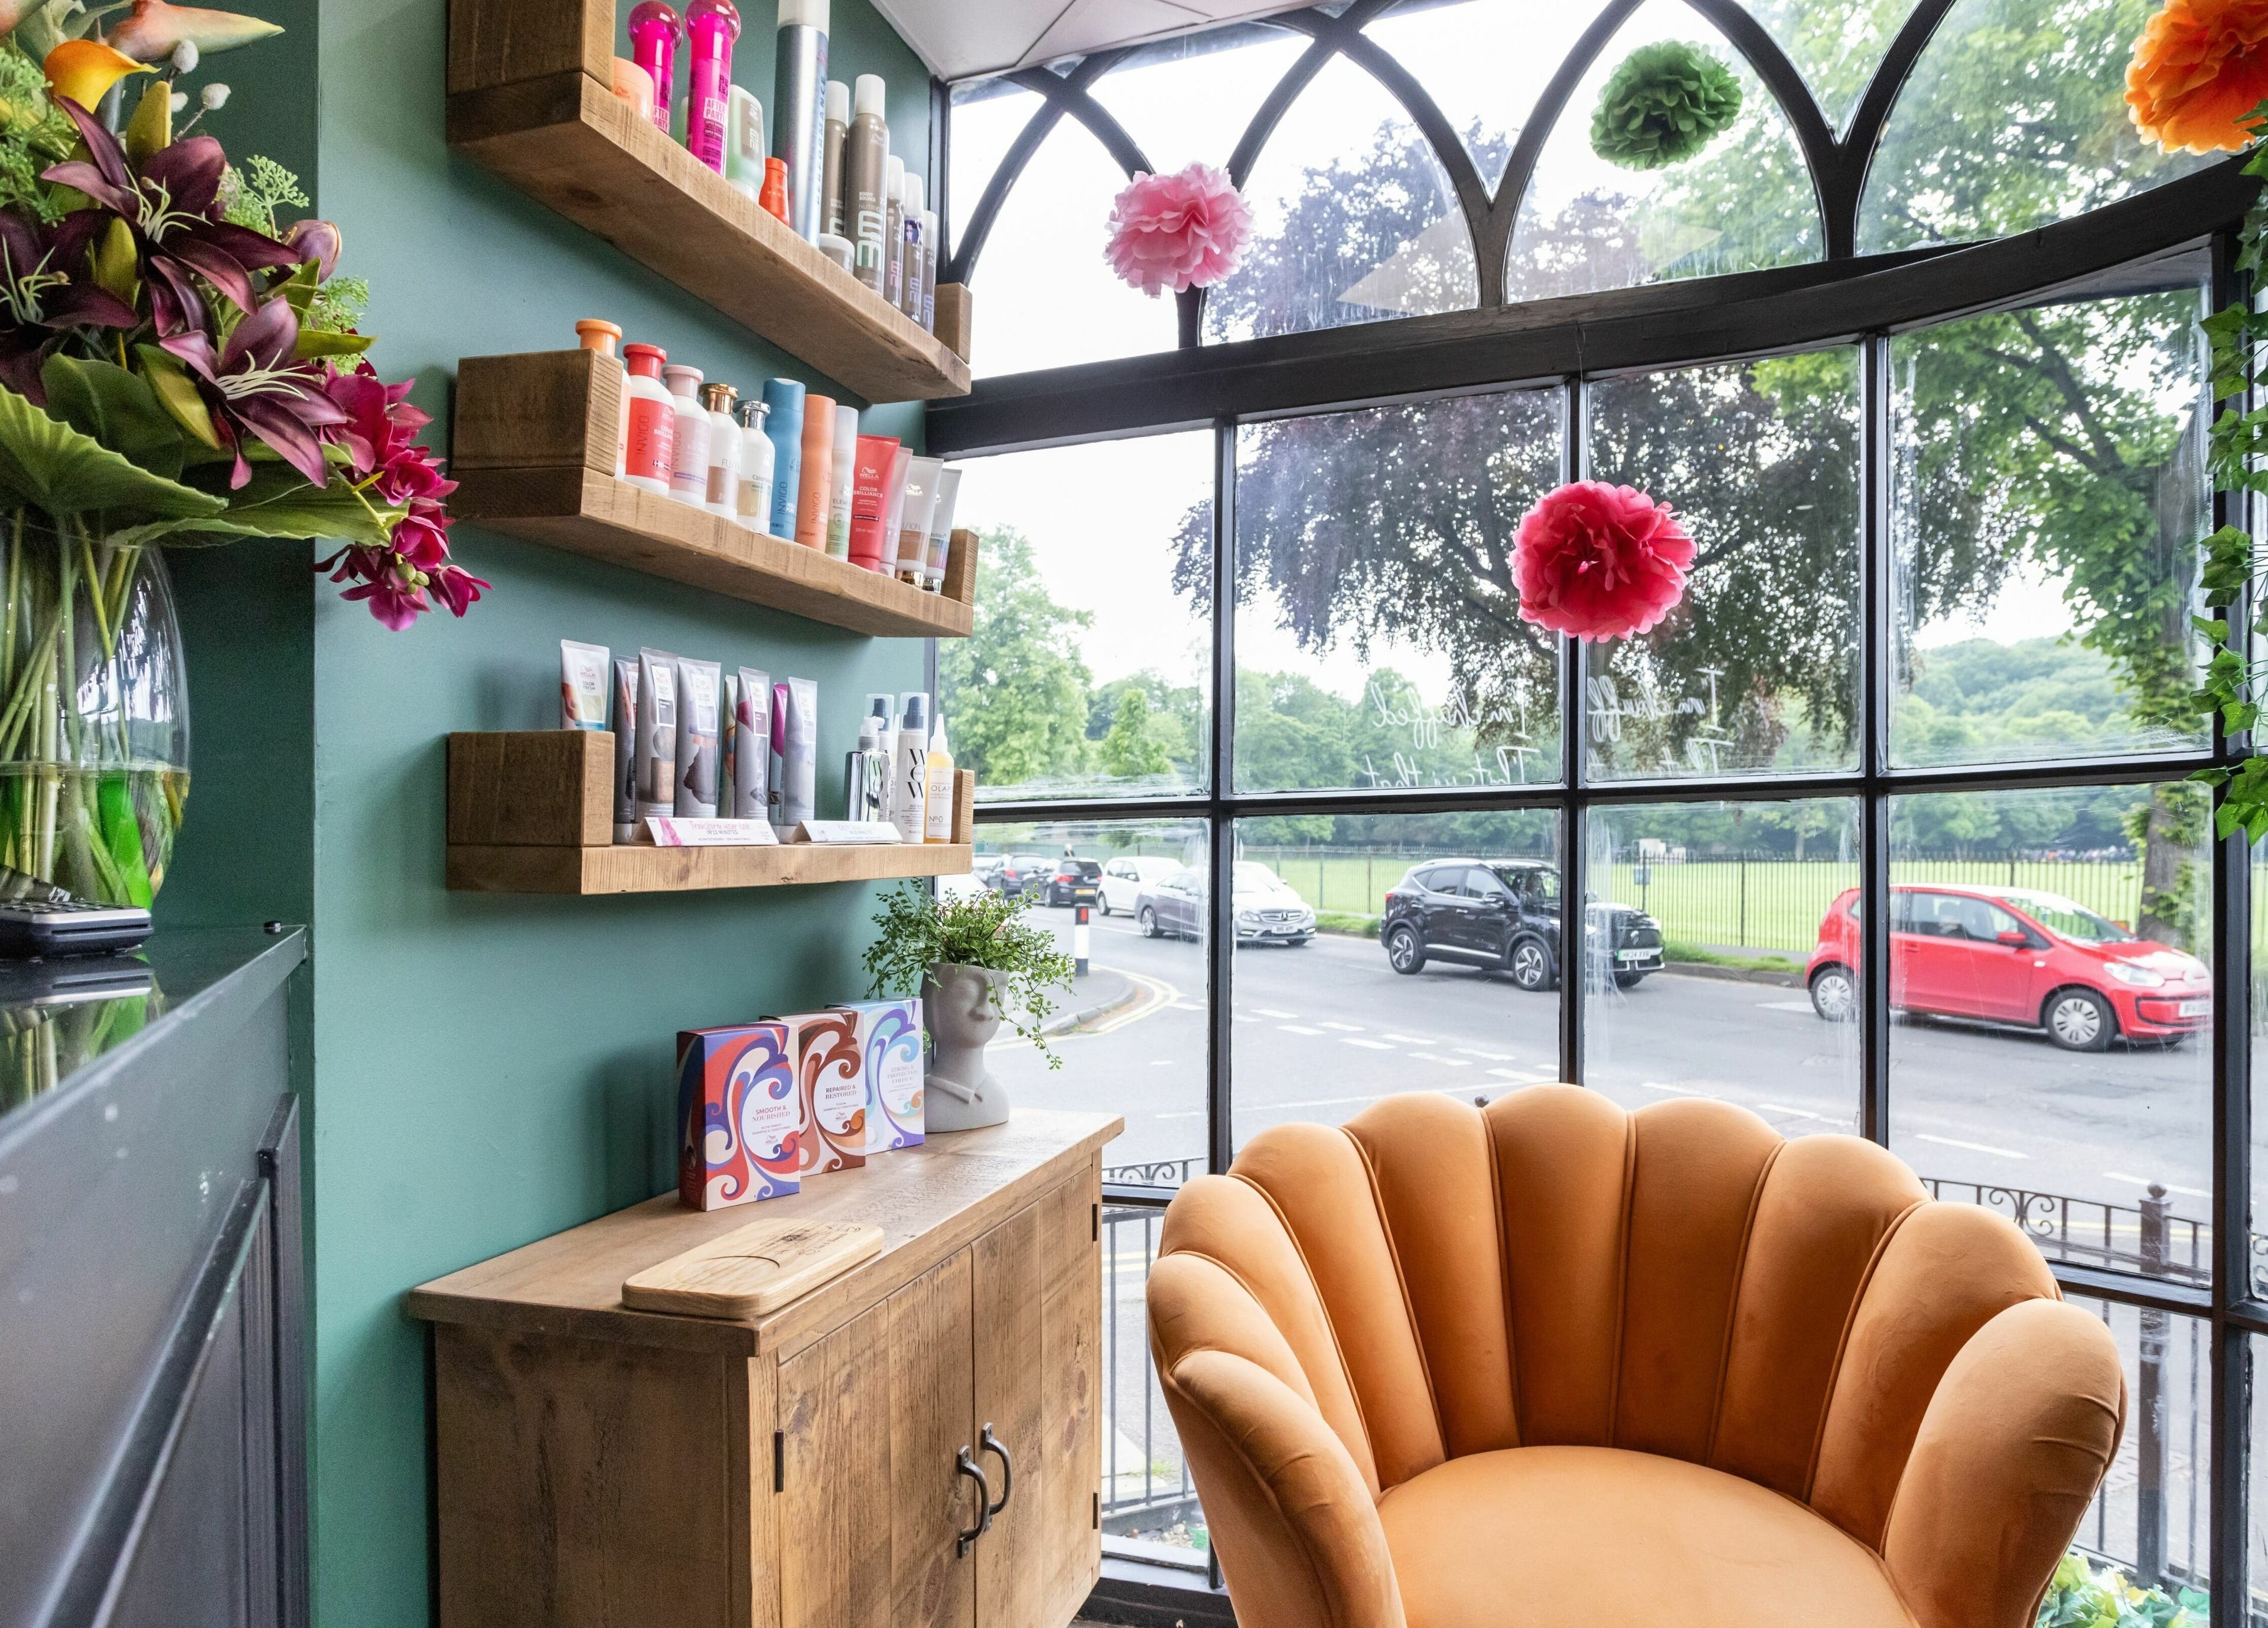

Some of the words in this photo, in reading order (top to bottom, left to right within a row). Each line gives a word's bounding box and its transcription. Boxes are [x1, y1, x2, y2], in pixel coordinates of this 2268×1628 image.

[706, 99, 725, 113] AFTER
[636, 415, 649, 455] INVIGO
[777, 481, 788, 515] INVIGO
[811, 492, 821, 523] INVIGO
[825, 1090, 856, 1099] RESTORED
[826, 1085, 851, 1093] REPAIRED
[752, 1111, 790, 1122] NOURISHED
[755, 1106, 781, 1115] SMOOTH
